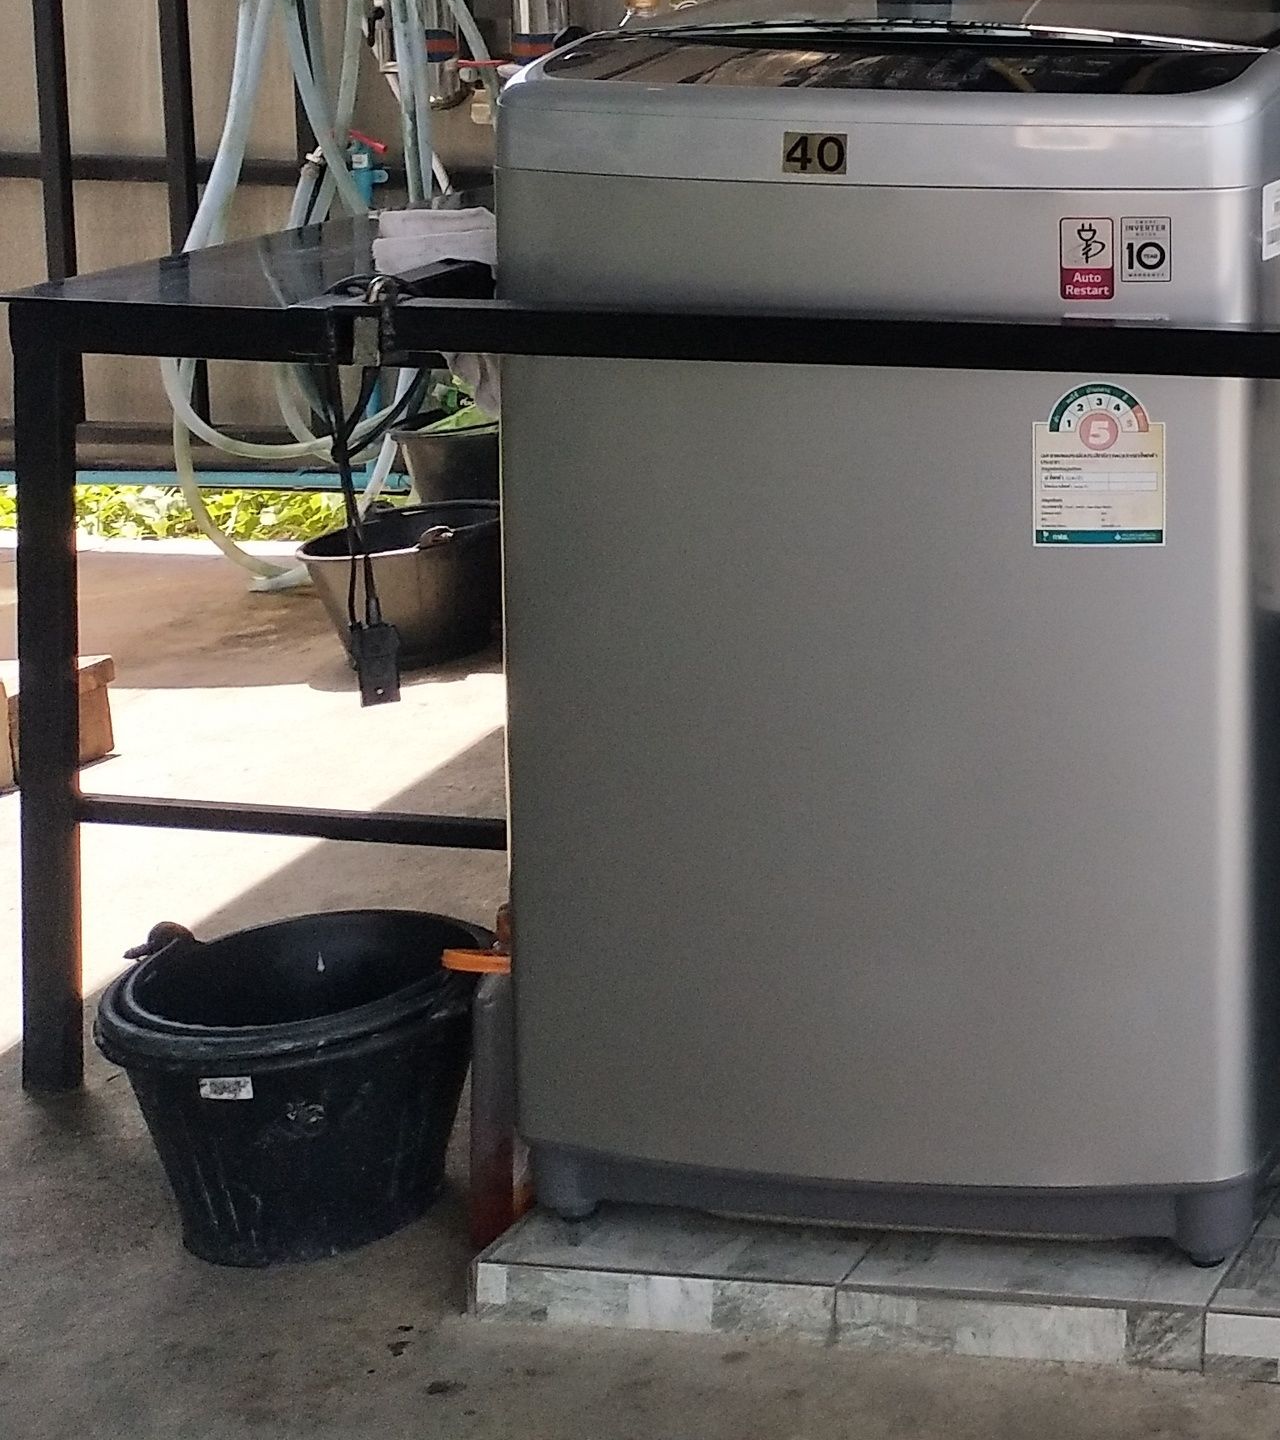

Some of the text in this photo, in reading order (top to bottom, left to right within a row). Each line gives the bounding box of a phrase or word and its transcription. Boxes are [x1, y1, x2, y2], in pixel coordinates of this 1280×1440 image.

[785, 135, 845, 172] 40
[1125, 224, 1166, 232] INVERTER
[1126, 241, 1166, 270] 10
[1072, 272, 1102, 283] Auto
[1065, 284, 1110, 296] Restart
[1096, 397, 1103, 406] 3
[1076, 403, 1084, 412] 2
[1113, 403, 1121, 412] 4
[1066, 419, 1071, 428] 1
[1088, 420, 1111, 446] 5
